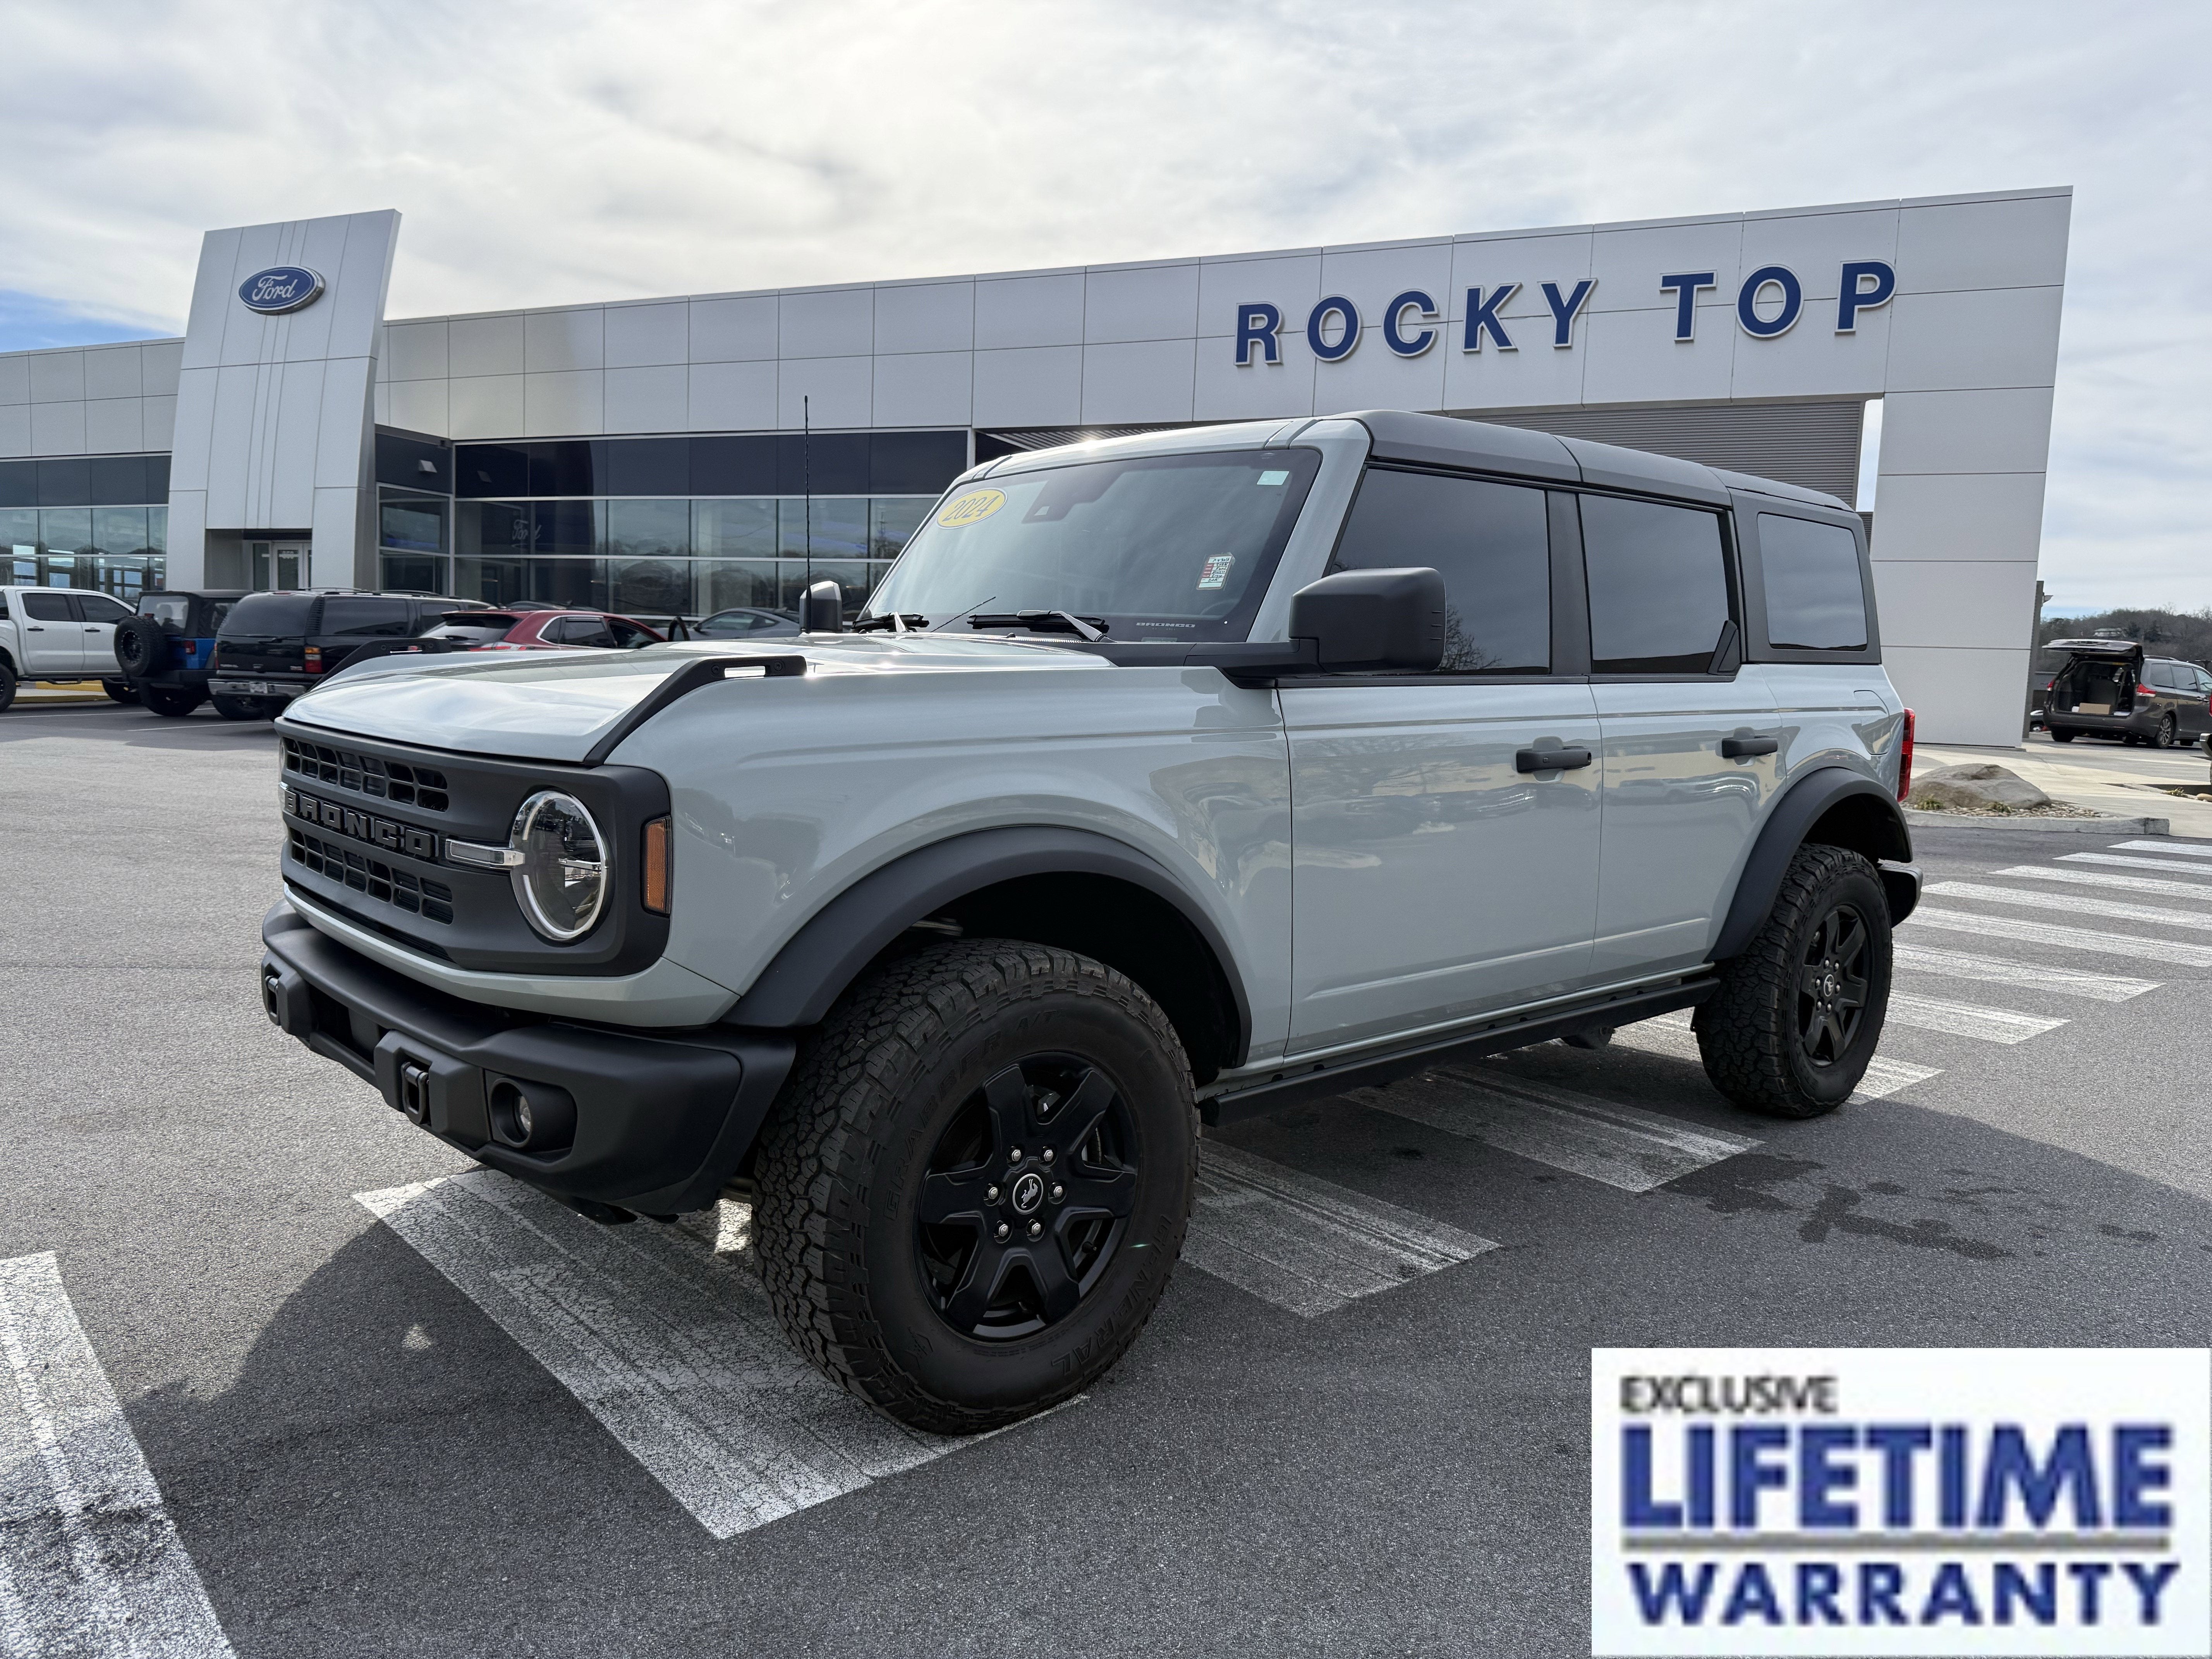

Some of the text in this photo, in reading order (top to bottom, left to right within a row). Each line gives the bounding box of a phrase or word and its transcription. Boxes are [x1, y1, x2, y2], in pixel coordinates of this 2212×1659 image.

[252, 275, 298, 301] Ford
[1234, 258, 1897, 366] ROCKY TOP
[942, 495, 1000, 522] 2024
[284, 789, 436, 859] BRONCO
[1051, 1214, 1173, 1376] GENERAL
